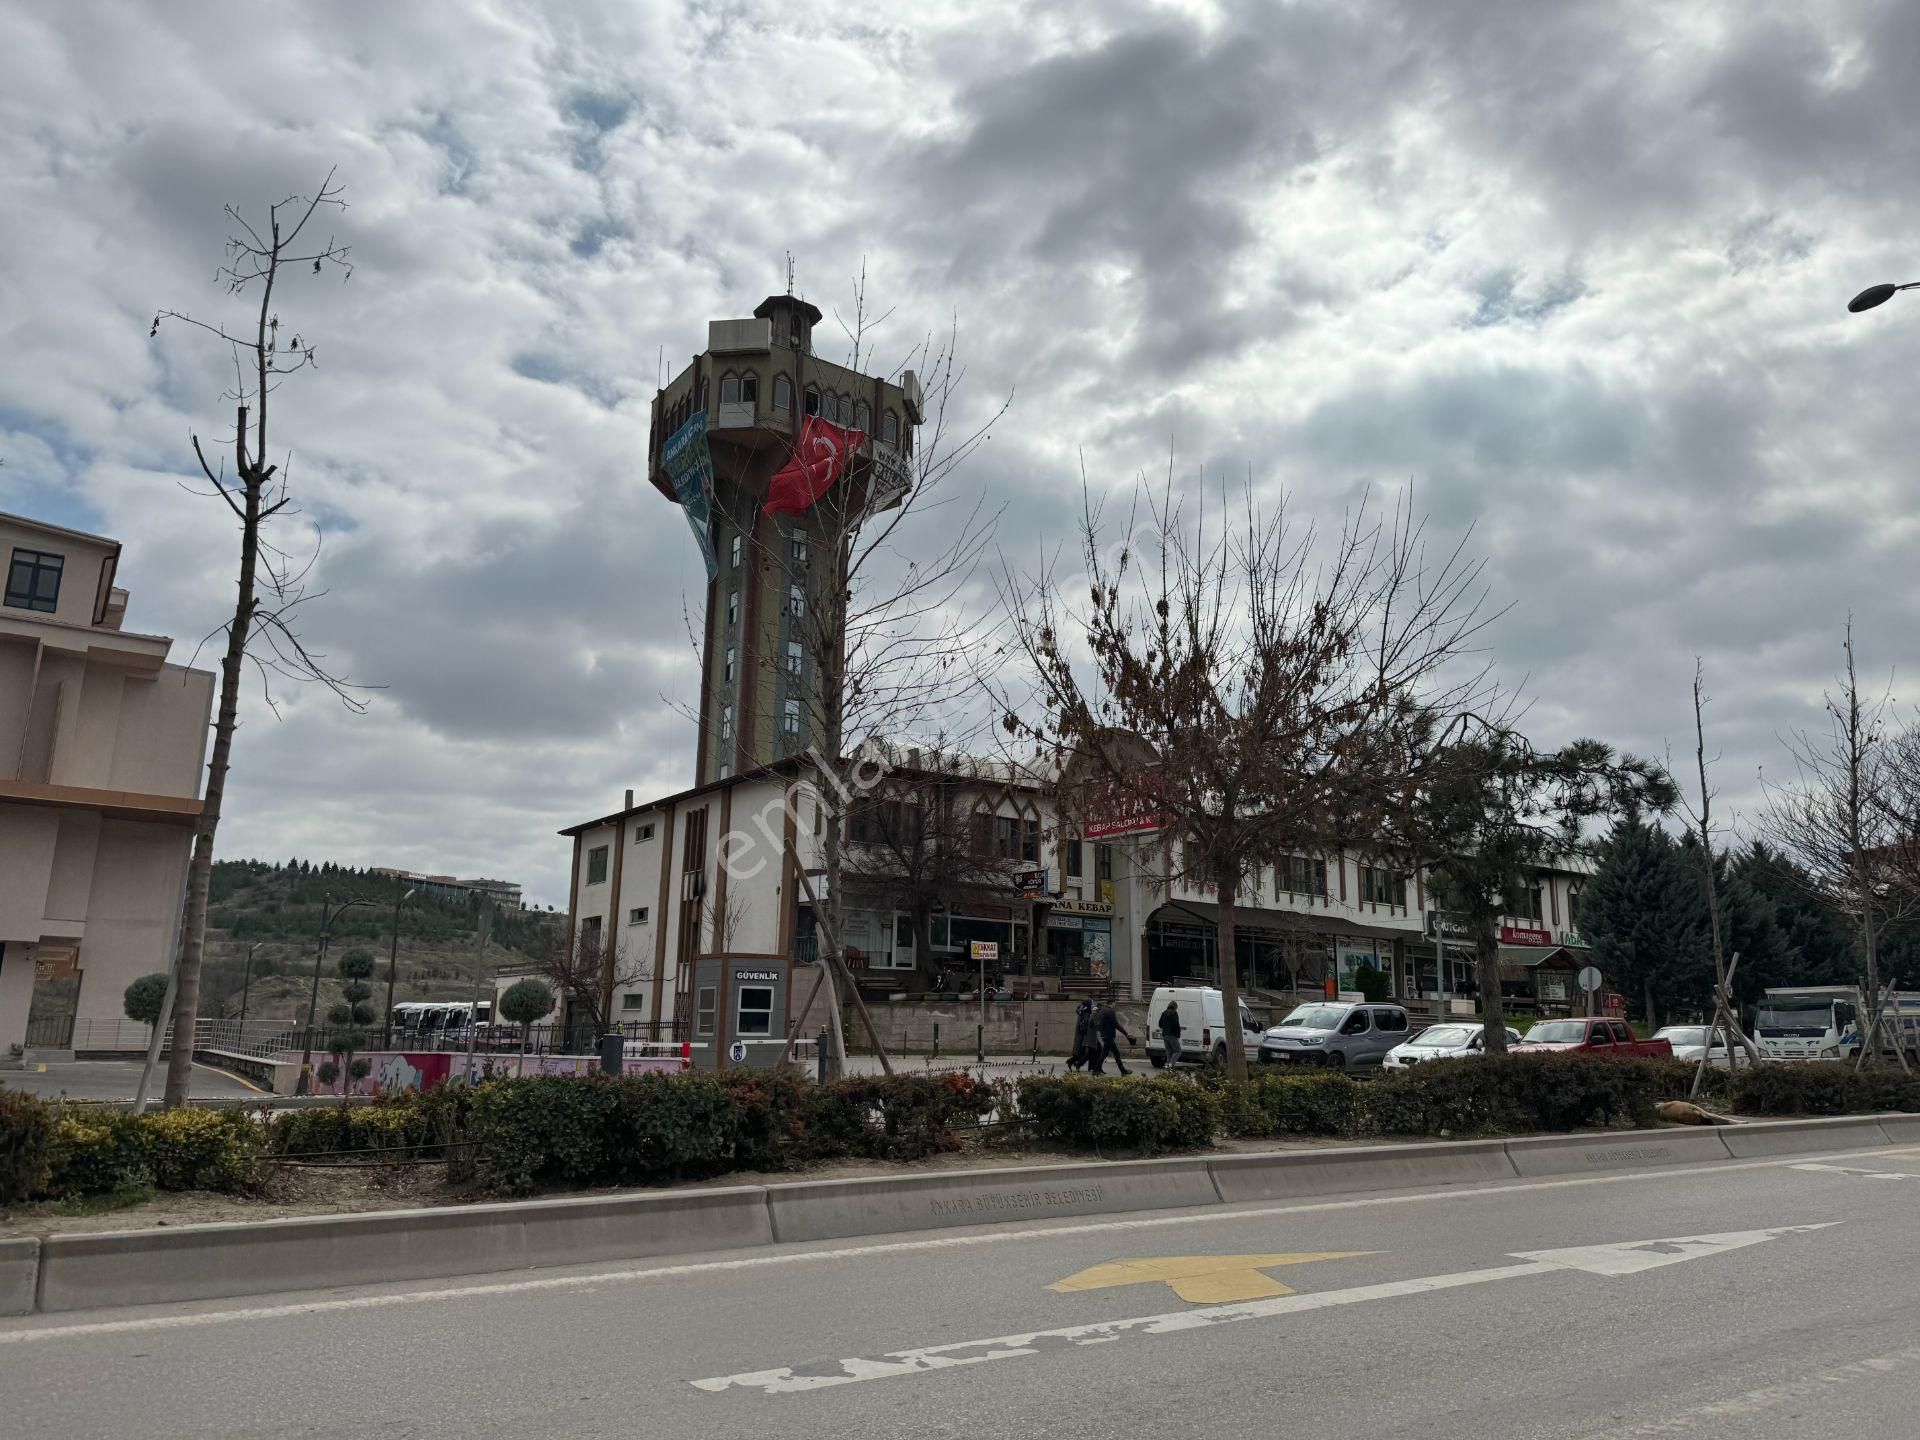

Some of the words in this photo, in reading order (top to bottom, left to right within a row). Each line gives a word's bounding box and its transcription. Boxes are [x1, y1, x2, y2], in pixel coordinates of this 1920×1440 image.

[1050, 901, 1073, 910] ANA
[1078, 903, 1112, 912] KEBAP
[736, 970, 779, 981] GÜVENLİK
[928, 1198, 974, 1216] ANKARA
[976, 1190, 1042, 1212] BÜYÜKŞEHİR
[1043, 1183, 1104, 1205] BELEDİYESİ
